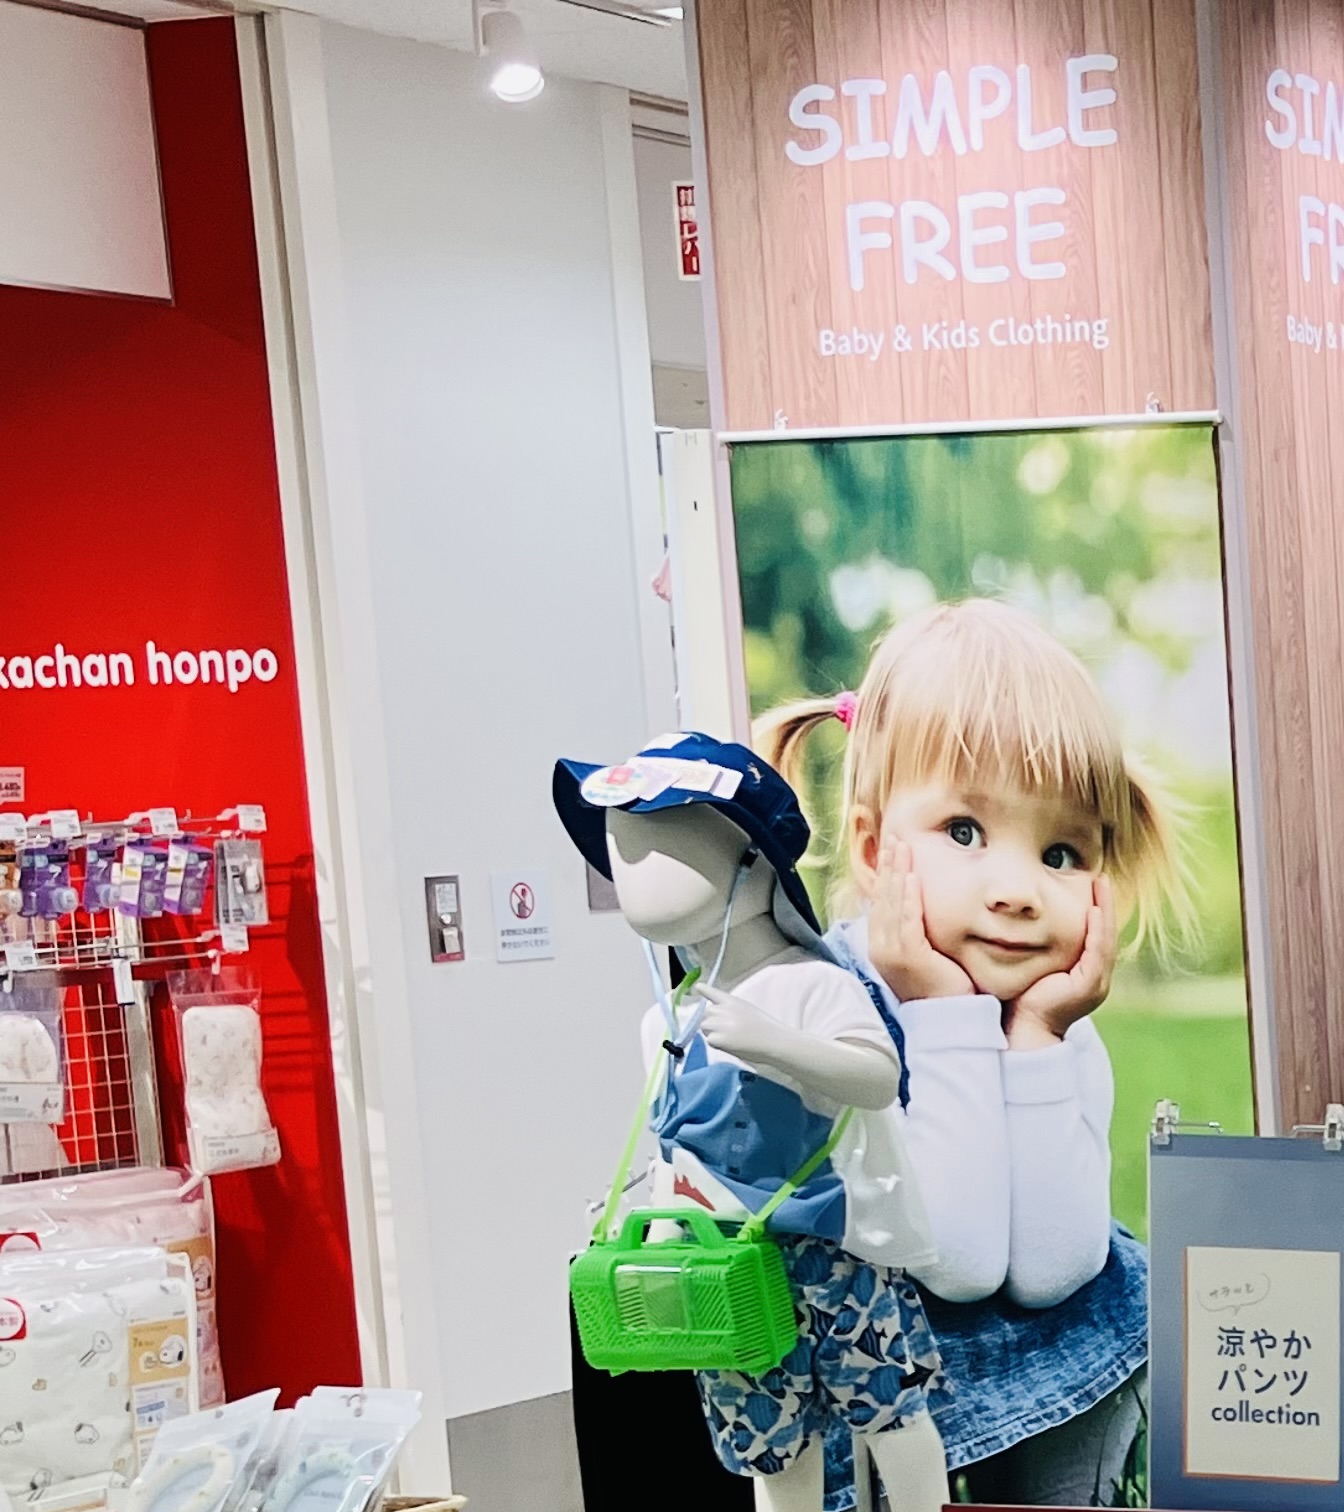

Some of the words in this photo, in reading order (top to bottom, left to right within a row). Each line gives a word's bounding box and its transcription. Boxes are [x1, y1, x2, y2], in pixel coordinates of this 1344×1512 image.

[786, 54, 1118, 166] SIMPLE
[845, 187, 1066, 291] FREE
[818, 327, 884, 361] Baby
[893, 324, 912, 352] &
[922, 321, 980, 350] Kids
[988, 314, 1111, 350] Clothing
[1286, 314, 1322, 353] Baby
[1326, 321, 1337, 349] &
[146, 640, 278, 693] honpo
[1217, 1325, 1312, 1360] 涼やか
[1217, 1363, 1309, 1396] パンツ
[1211, 1400, 1321, 1427] collection
